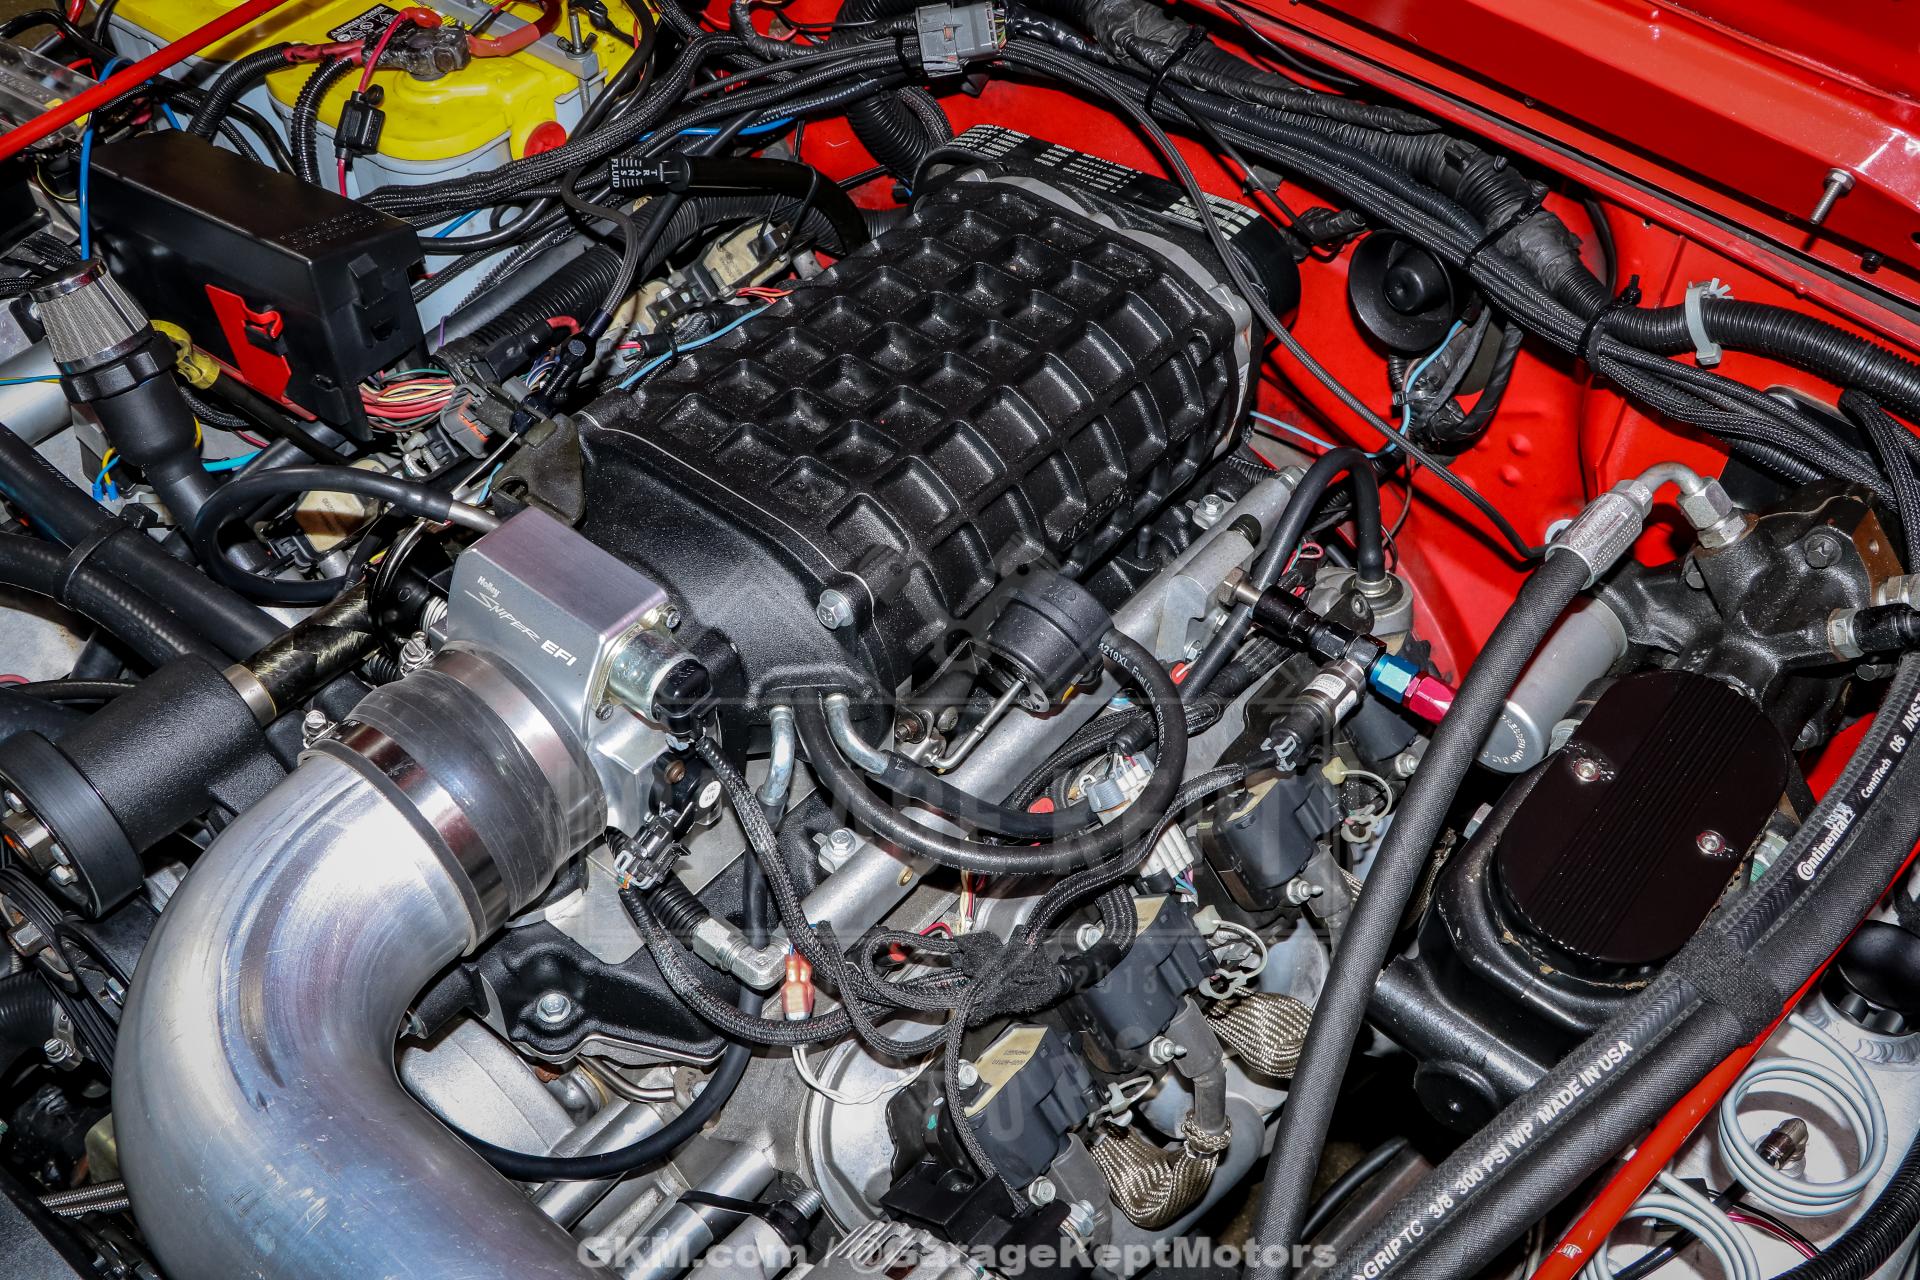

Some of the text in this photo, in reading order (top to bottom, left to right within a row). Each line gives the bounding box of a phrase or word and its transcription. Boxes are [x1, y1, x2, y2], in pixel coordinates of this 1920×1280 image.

[610, 158, 621, 188] FLUID
[477, 575, 502, 599] Holley
[464, 589, 578, 667] SNIPER EFI
[1131, 665, 1147, 688] Fuel
[1797, 808, 1853, 881] Continental
[1861, 757, 1893, 799] ContiTech
[1889, 734, 1906, 754] 06
[1351, 1039, 1634, 1280] GRIP TC 3/8 300 PSI WP MADE IN USA
